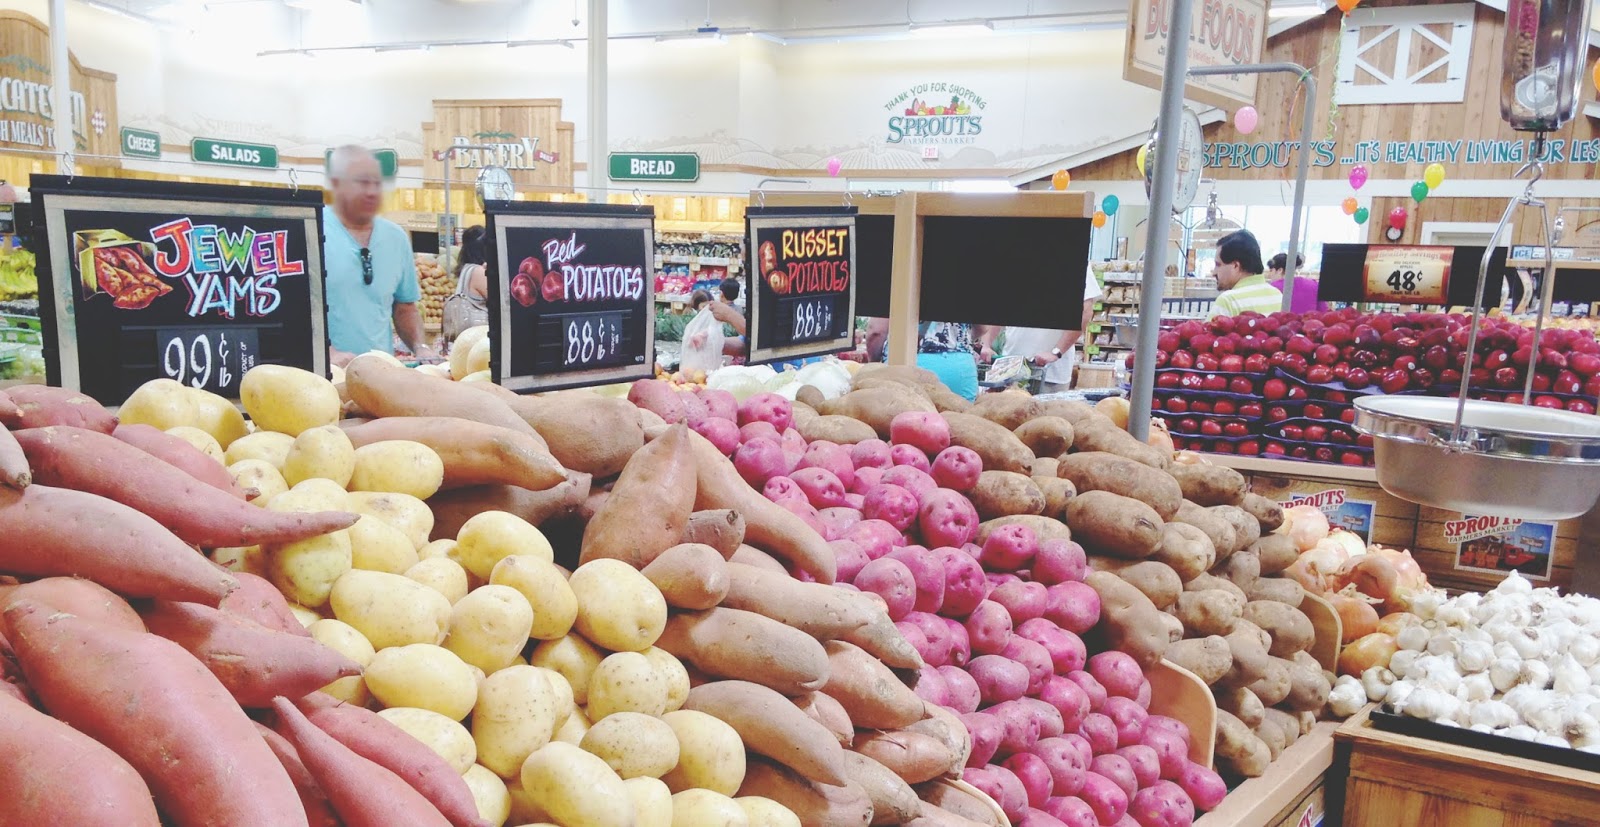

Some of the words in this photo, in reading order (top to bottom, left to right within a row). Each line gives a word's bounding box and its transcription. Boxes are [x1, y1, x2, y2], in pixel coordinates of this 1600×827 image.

[884, 91, 909, 111] THANK
[910, 83, 929, 97] YOU
[930, 82, 947, 92] FOR
[948, 84, 988, 111] SHOPPING
[11, 121, 45, 147] MEALS
[127, 134, 157, 153] CHEESE
[886, 116, 982, 144] SPROUTS
[903, 137, 939, 145] FARMERS
[941, 137, 976, 145] MARKET
[211, 144, 261, 164] SALADS
[453, 136, 539, 170] BAKERY
[924, 147, 936, 157] EXIT
[1385, 139, 1463, 165] HEALTHY
[1465, 139, 1523, 165] LIVING
[630, 158, 675, 176] BREAD
[150, 217, 304, 277] JEWEL
[542, 231, 586, 270] Red
[782, 228, 848, 260] RUSSET
[1513, 249, 1531, 258] ICE
[561, 266, 644, 300] POTATOES
[786, 260, 849, 294] POTATOES
[182, 272, 282, 319] YAMS
[1449, 531, 1483, 543] FARMERS
[1484, 524, 1515, 535] MARKET
